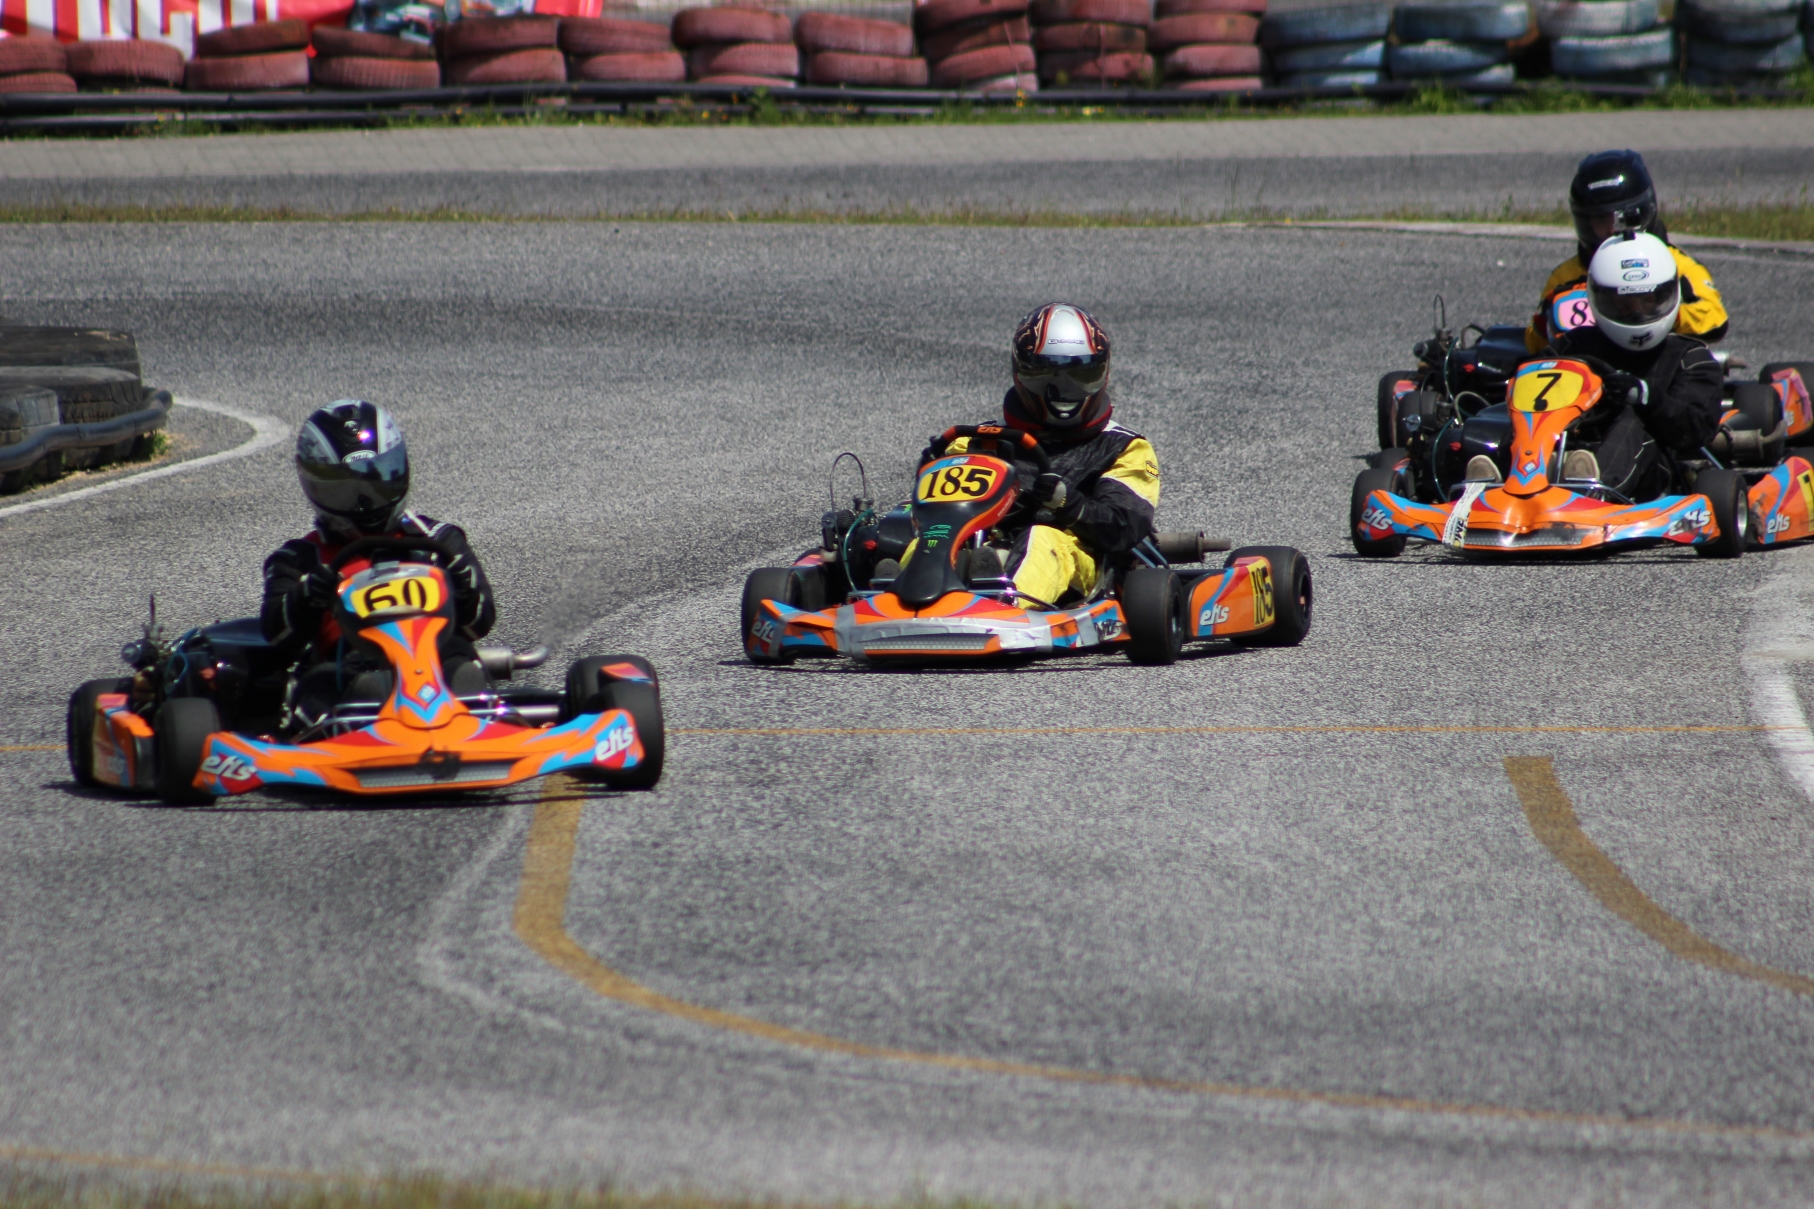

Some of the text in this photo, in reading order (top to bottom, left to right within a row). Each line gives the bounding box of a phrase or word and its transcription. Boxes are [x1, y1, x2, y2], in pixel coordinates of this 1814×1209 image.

[1537, 372, 1563, 412] 7
[920, 466, 993, 501] 185
[364, 578, 427, 613] 60
[1251, 565, 1274, 625] 185
